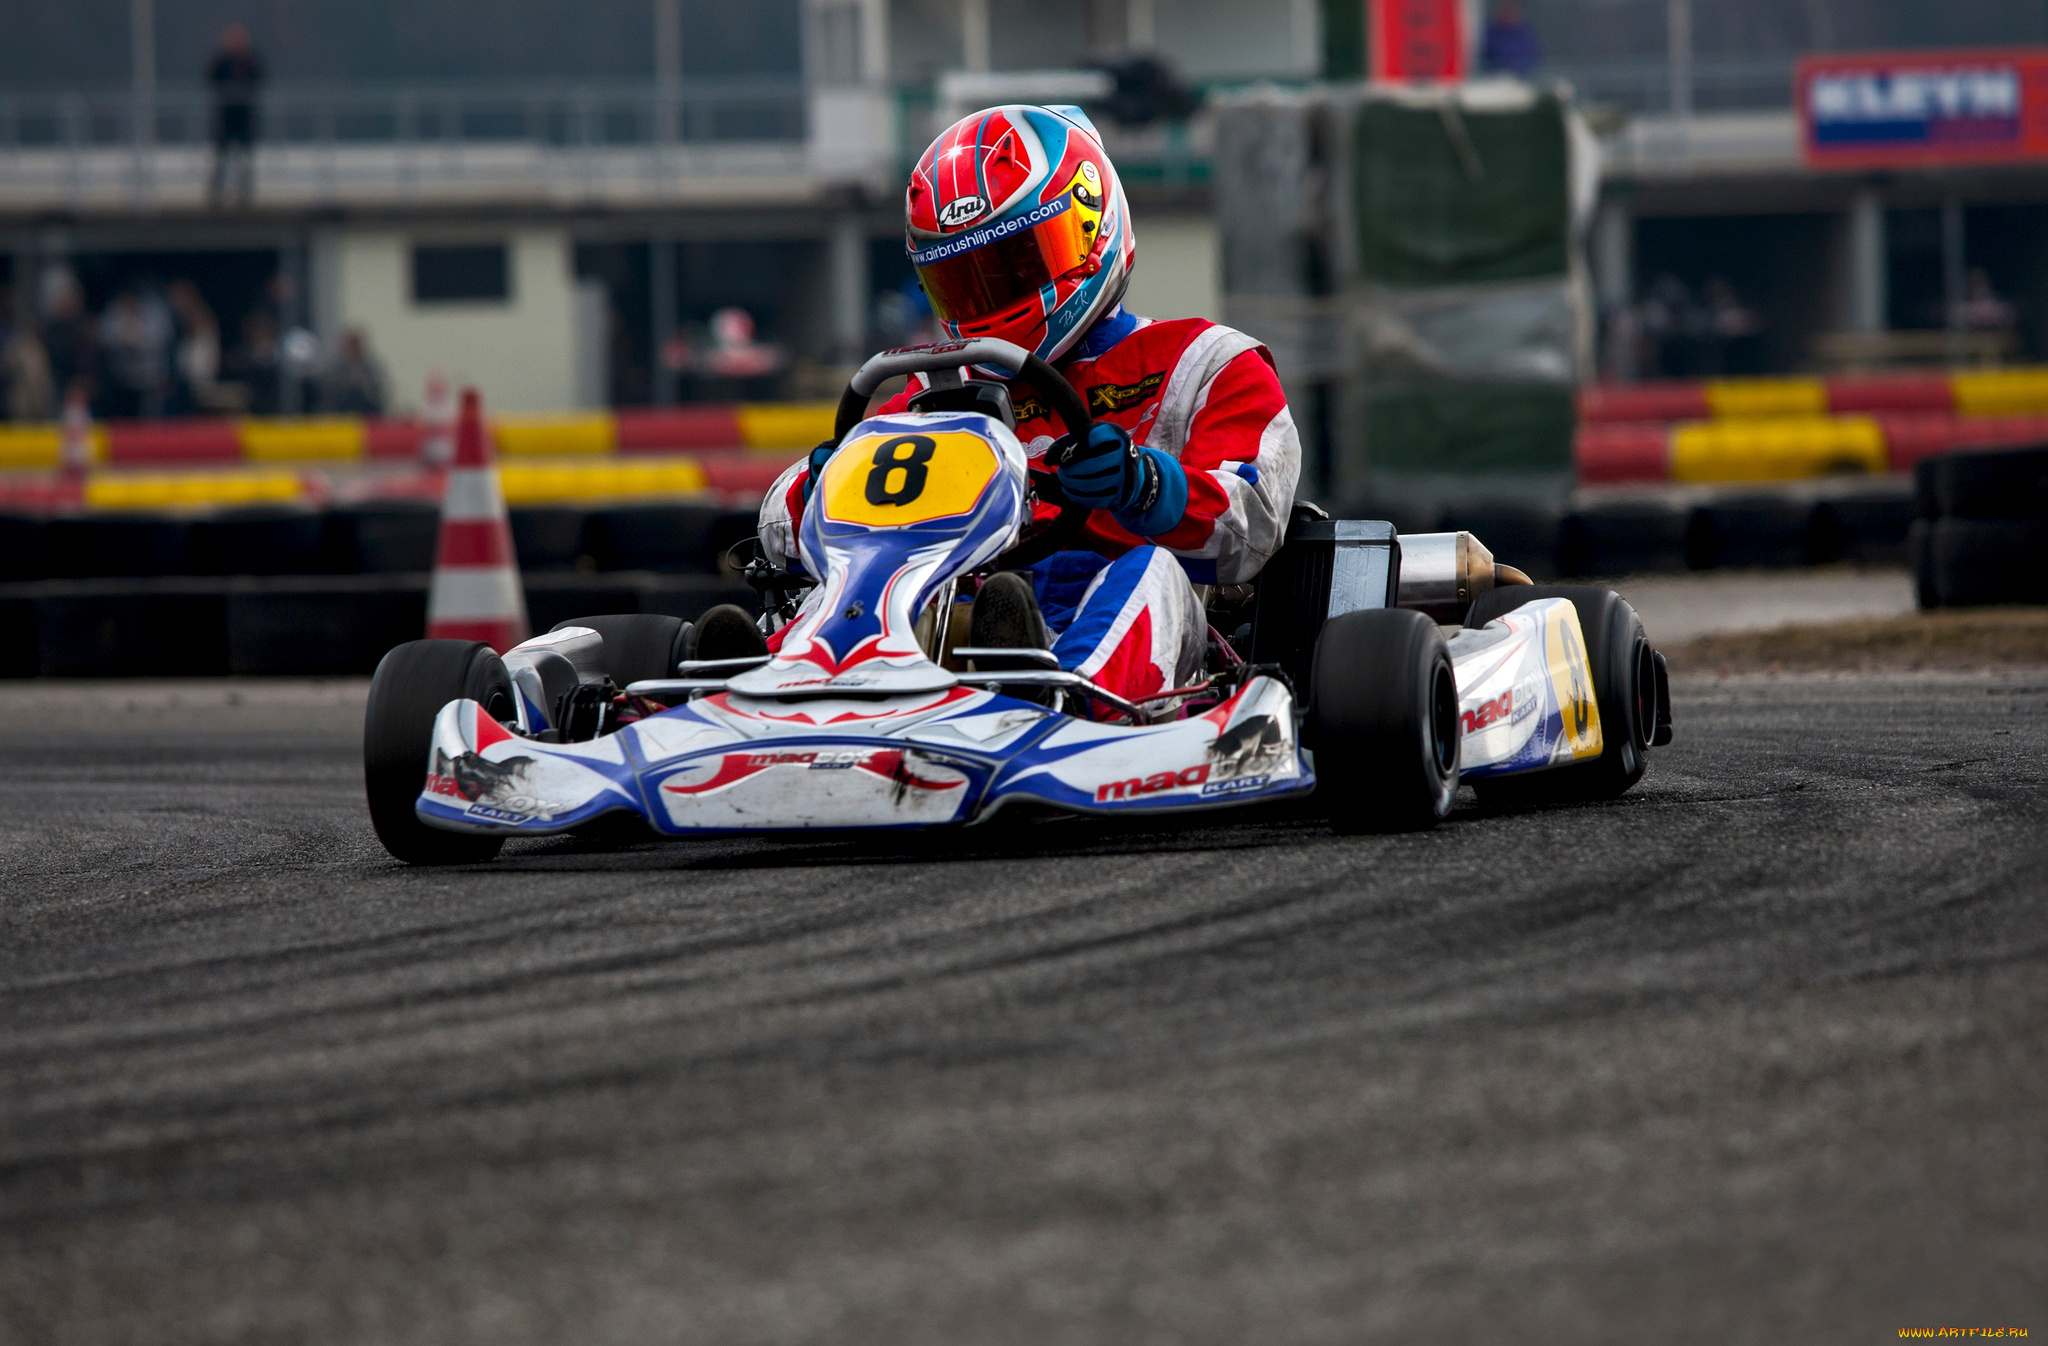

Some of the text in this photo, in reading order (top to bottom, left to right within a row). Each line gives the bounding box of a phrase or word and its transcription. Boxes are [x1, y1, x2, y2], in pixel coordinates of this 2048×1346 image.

[940, 195, 983, 225] Arai
[865, 435, 937, 507] 8
[1559, 618, 1588, 742] 8
[1205, 776, 1268, 793] KART
[471, 806, 522, 822] KART
